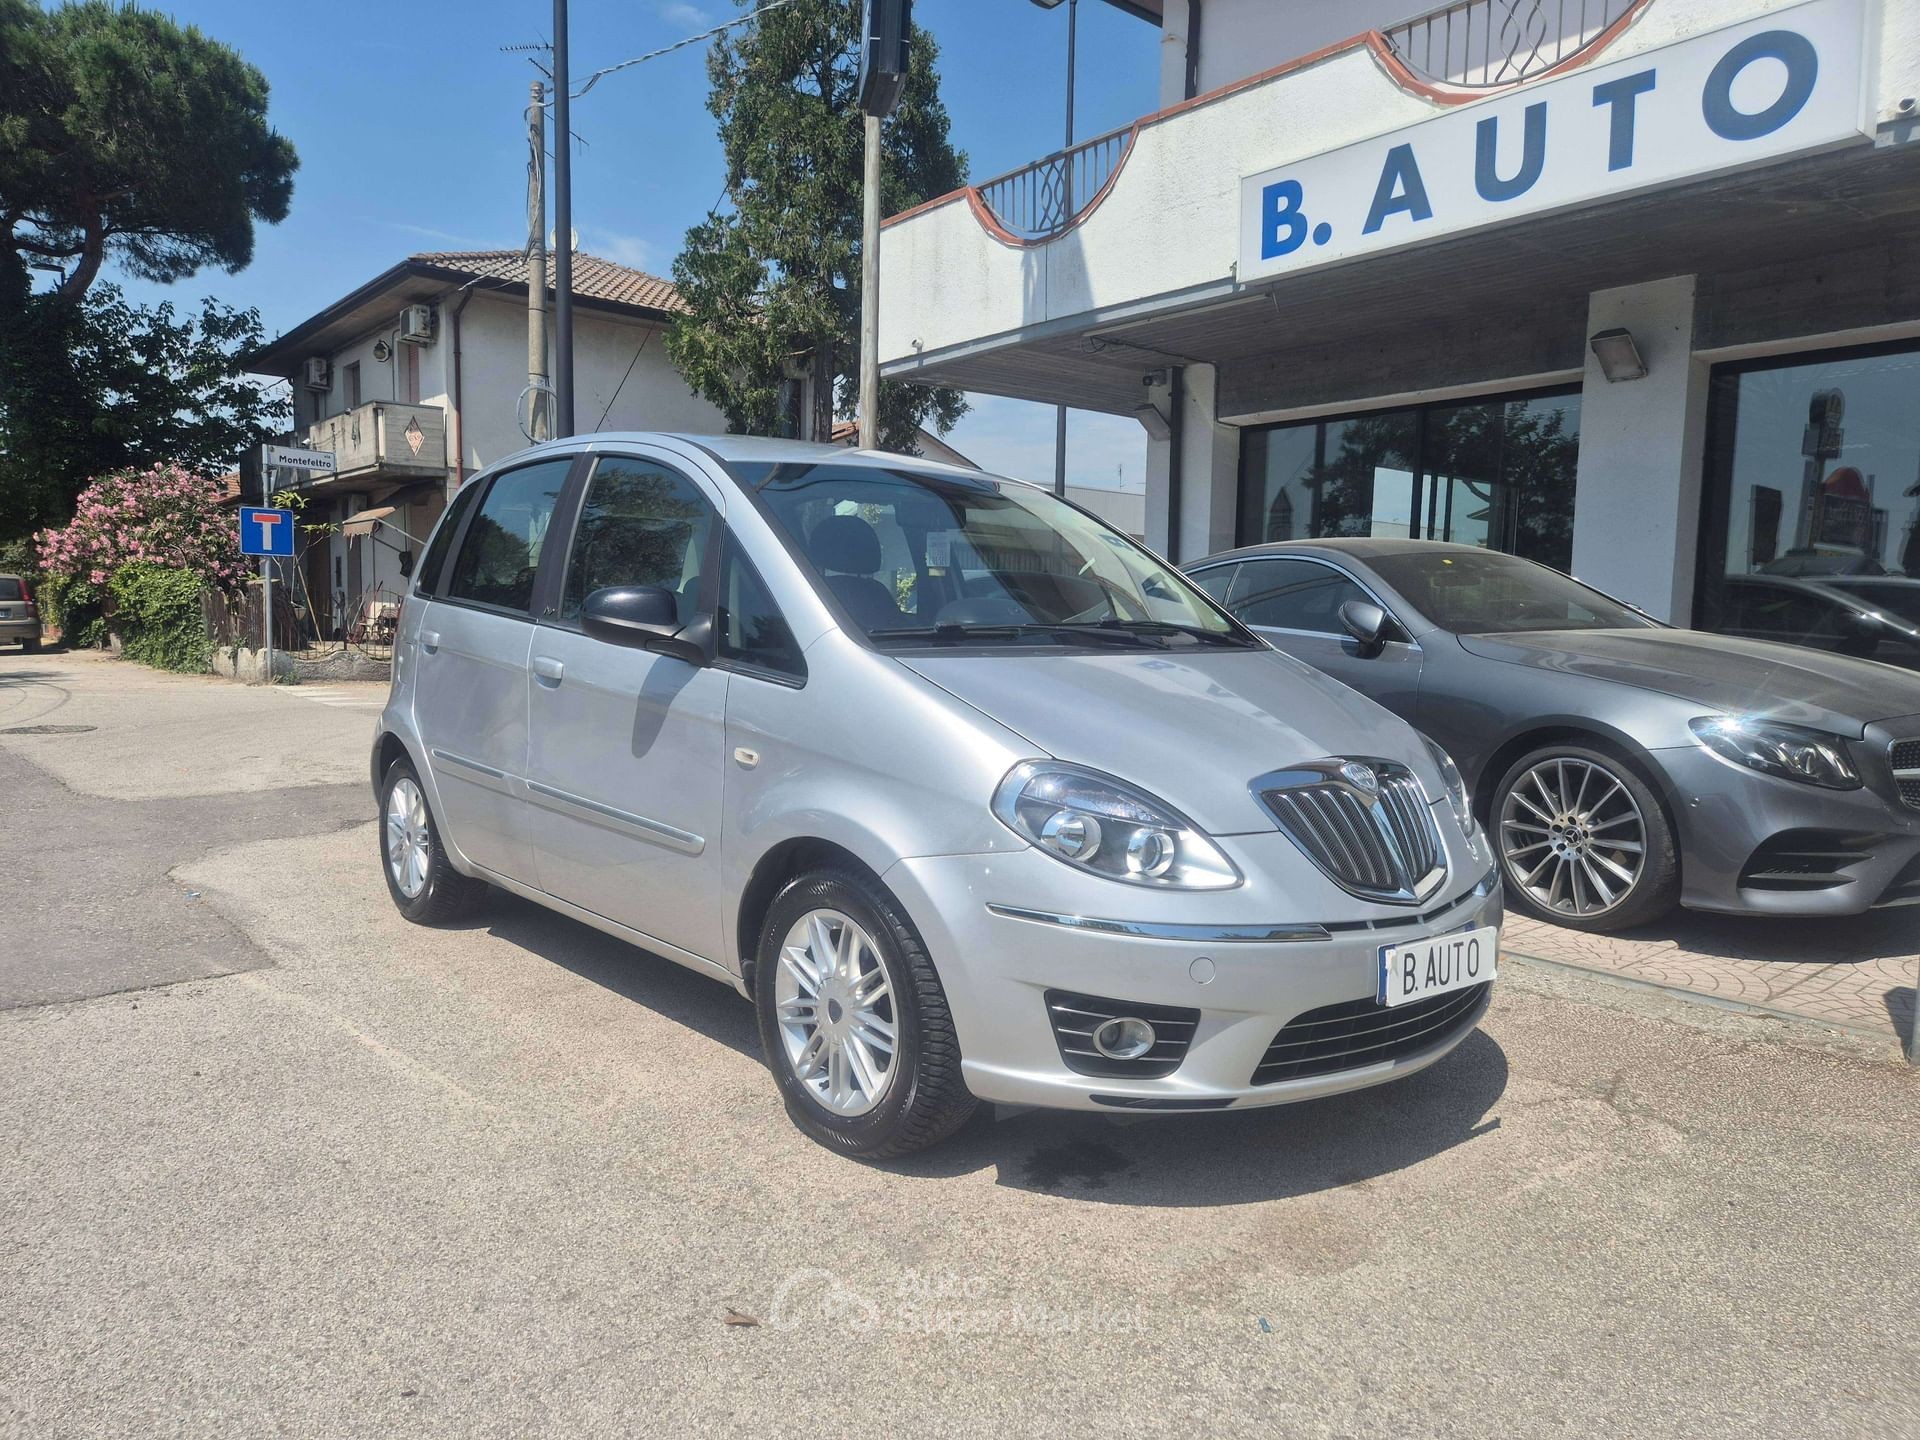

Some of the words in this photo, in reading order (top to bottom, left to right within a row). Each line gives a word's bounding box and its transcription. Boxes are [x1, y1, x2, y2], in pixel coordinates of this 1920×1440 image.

[1261, 179, 1332, 260] B.
[1362, 29, 1819, 235] AUTO
[279, 455, 332, 468] Montefeltro
[1403, 952, 1419, 995] B.
[1425, 938, 1480, 988] AUTO
